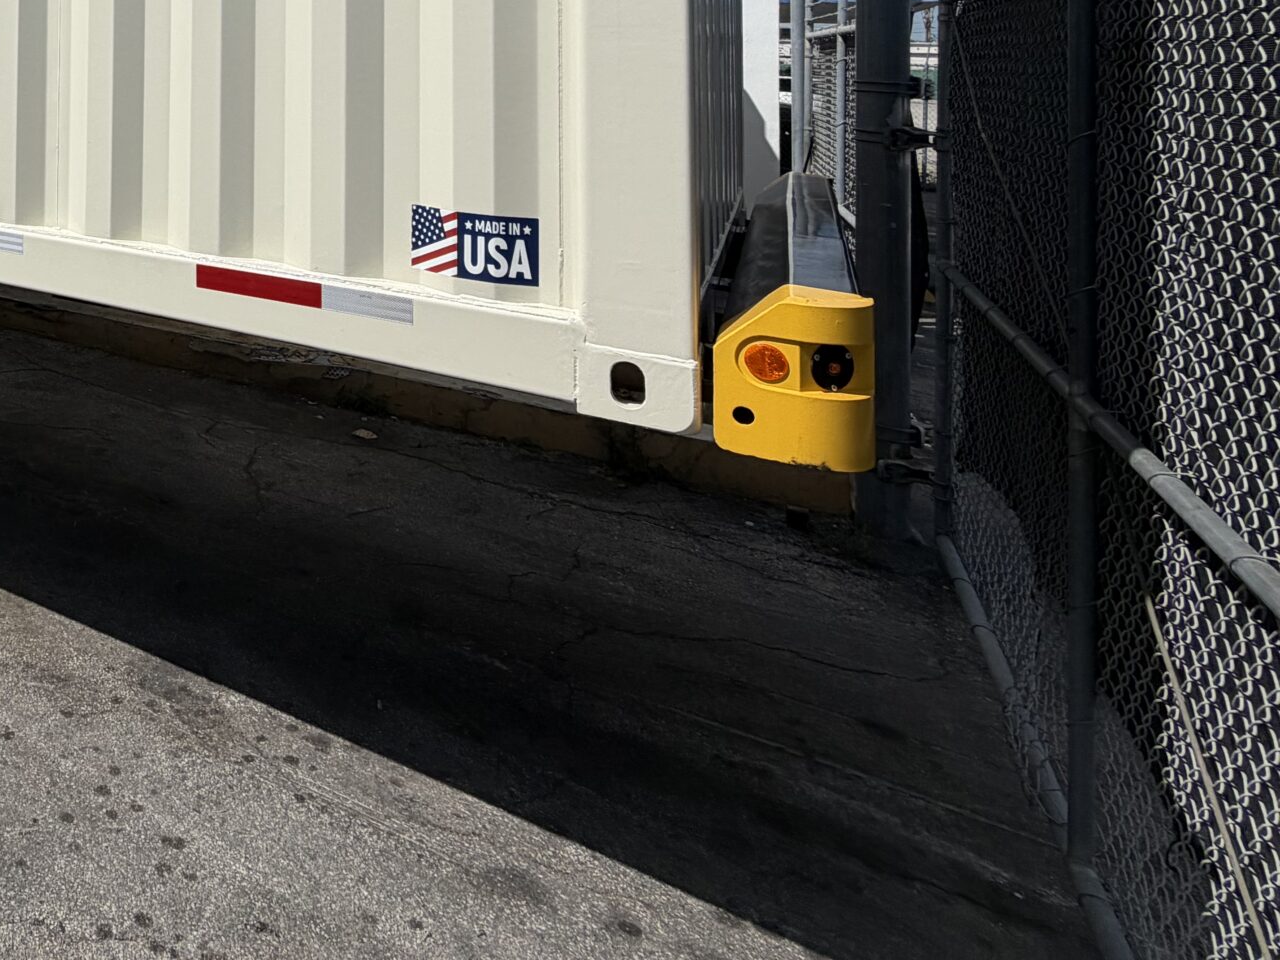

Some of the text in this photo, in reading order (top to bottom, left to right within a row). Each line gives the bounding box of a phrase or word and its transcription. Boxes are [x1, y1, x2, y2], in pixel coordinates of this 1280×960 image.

[475, 219, 521, 236] MADE IN
[464, 234, 532, 279] USA
